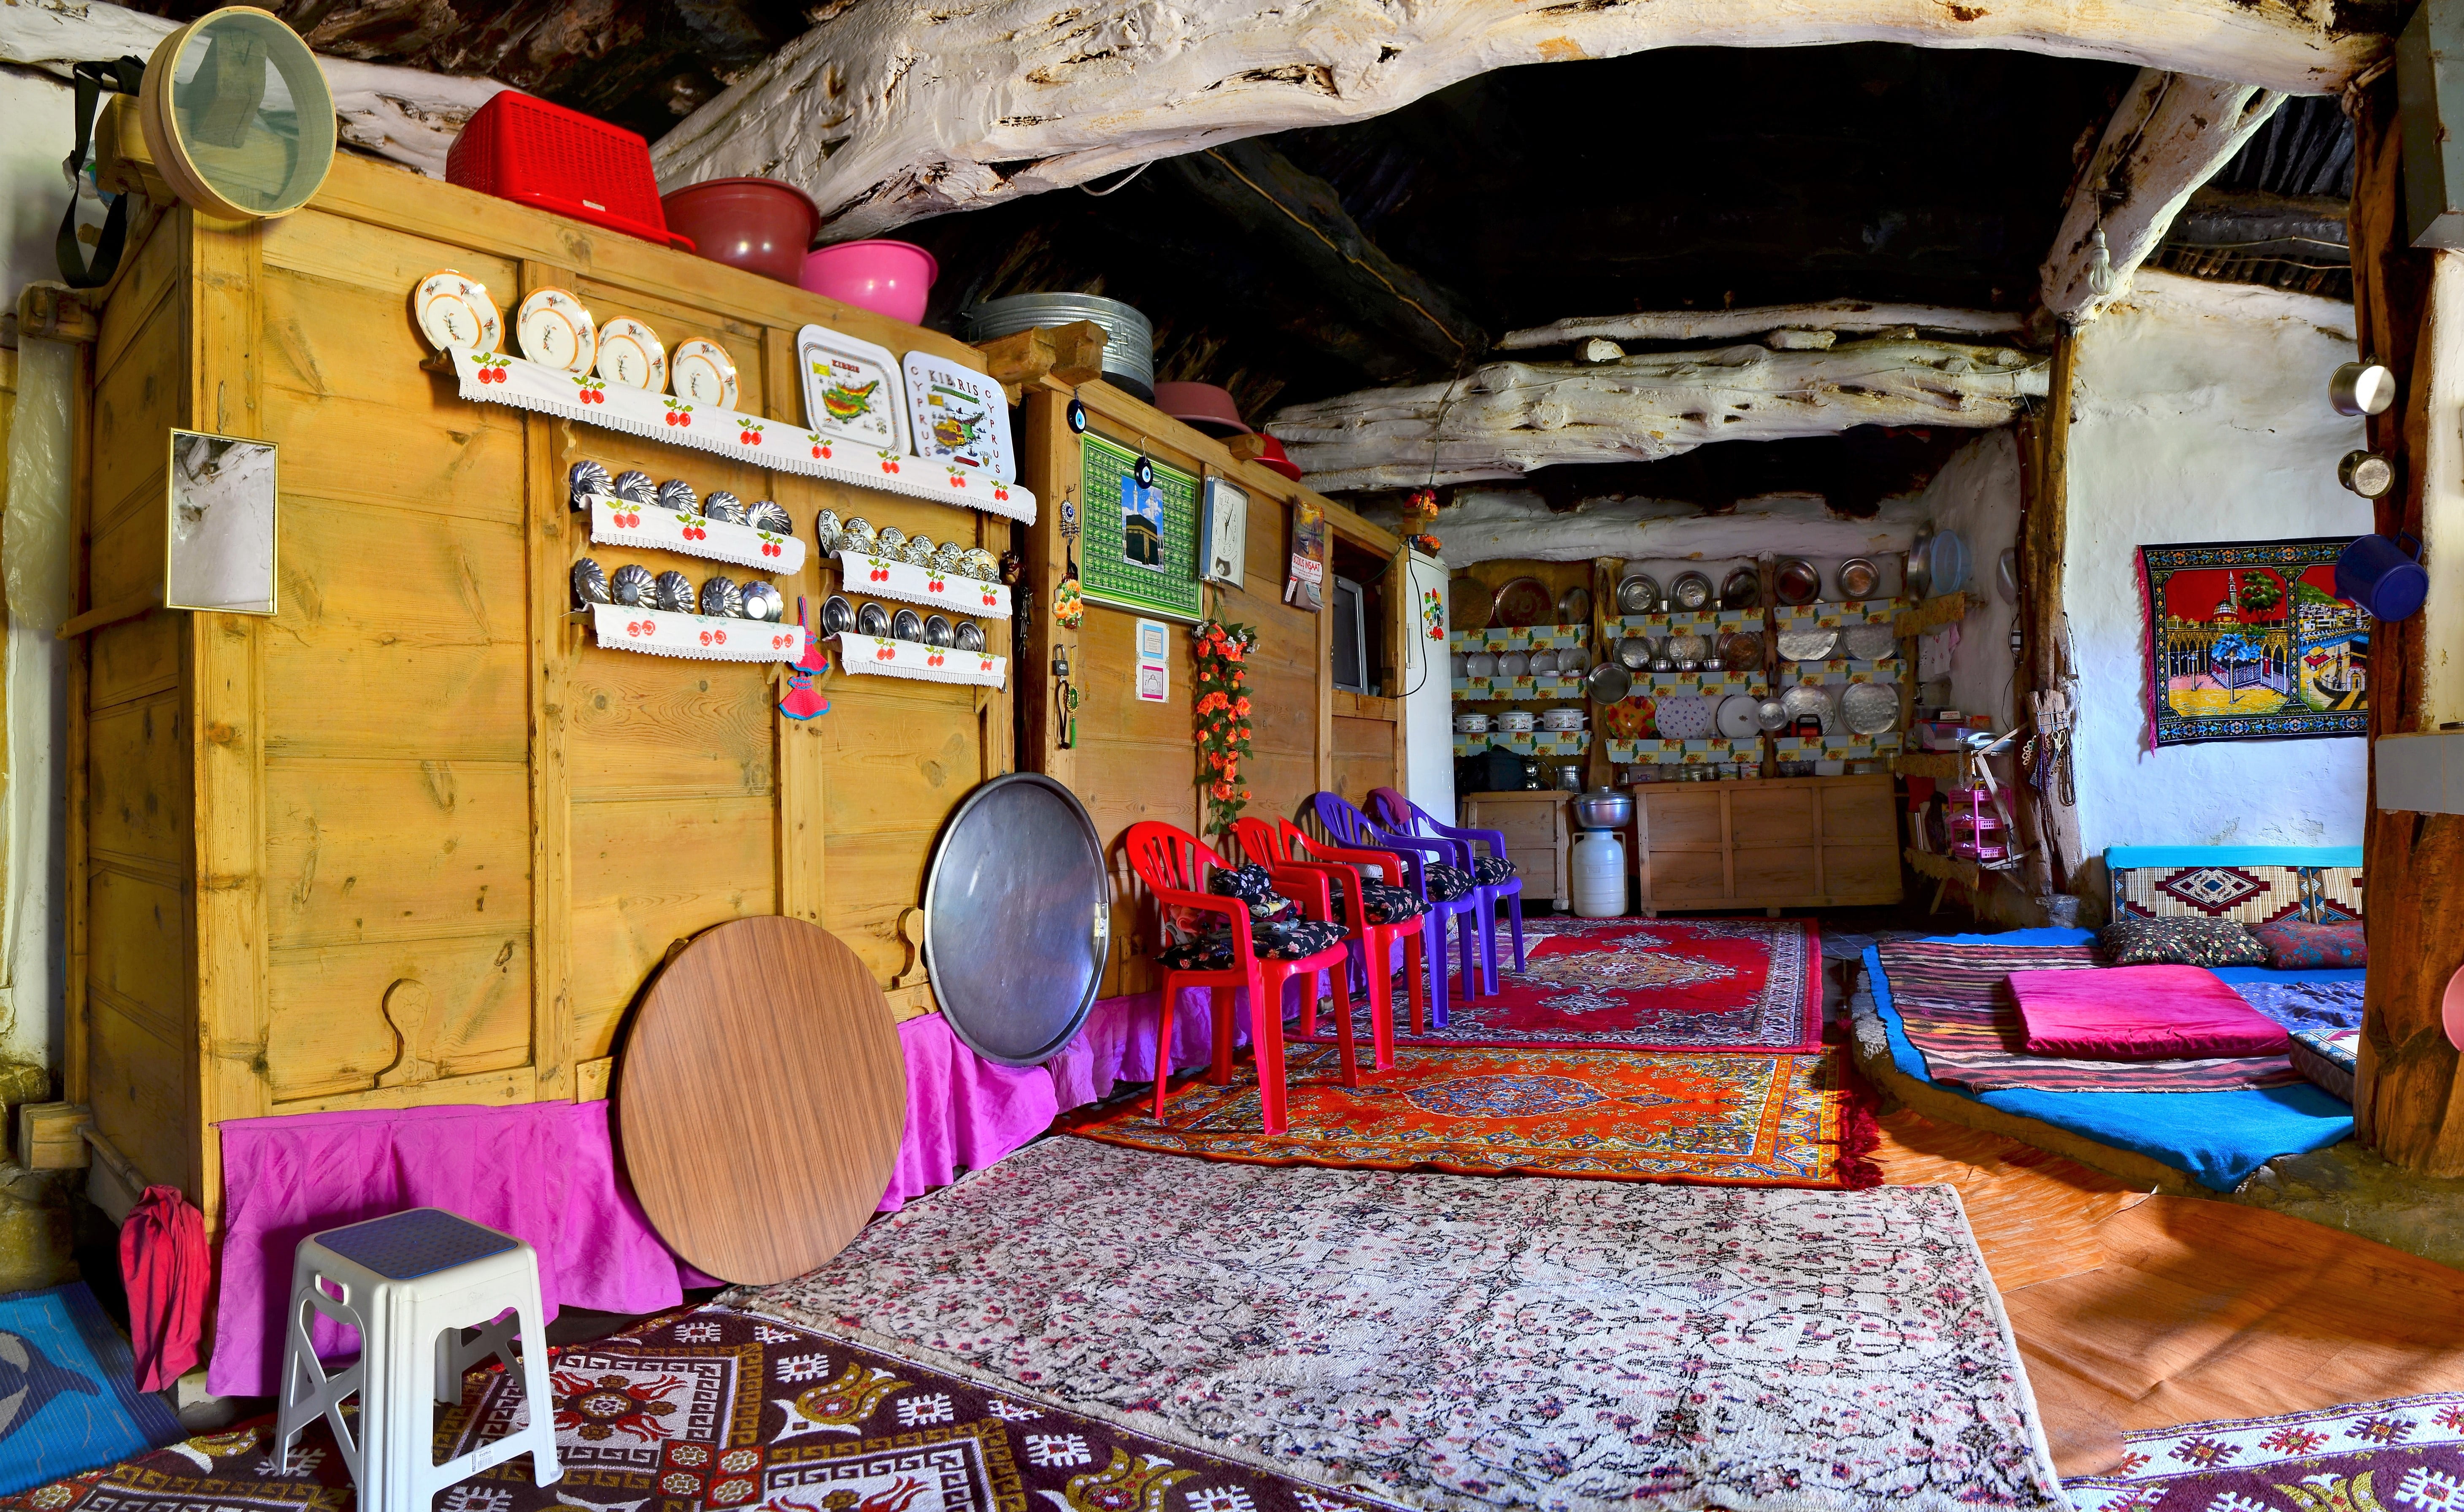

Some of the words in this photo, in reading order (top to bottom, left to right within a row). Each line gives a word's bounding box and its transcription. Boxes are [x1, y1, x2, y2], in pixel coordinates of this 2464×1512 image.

[928, 370, 979, 396] KIBRIS
[910, 366, 931, 457] CYPRUS
[985, 390, 1001, 473] CYPRUS
[979, 451, 992, 460] KIBRIS
[1219, 497, 1223, 505] 11
[1225, 495, 1229, 503] 12
[1216, 505, 1220, 514] 10
[1233, 514, 1236, 522] 2
[1224, 546, 1226, 554] 6
